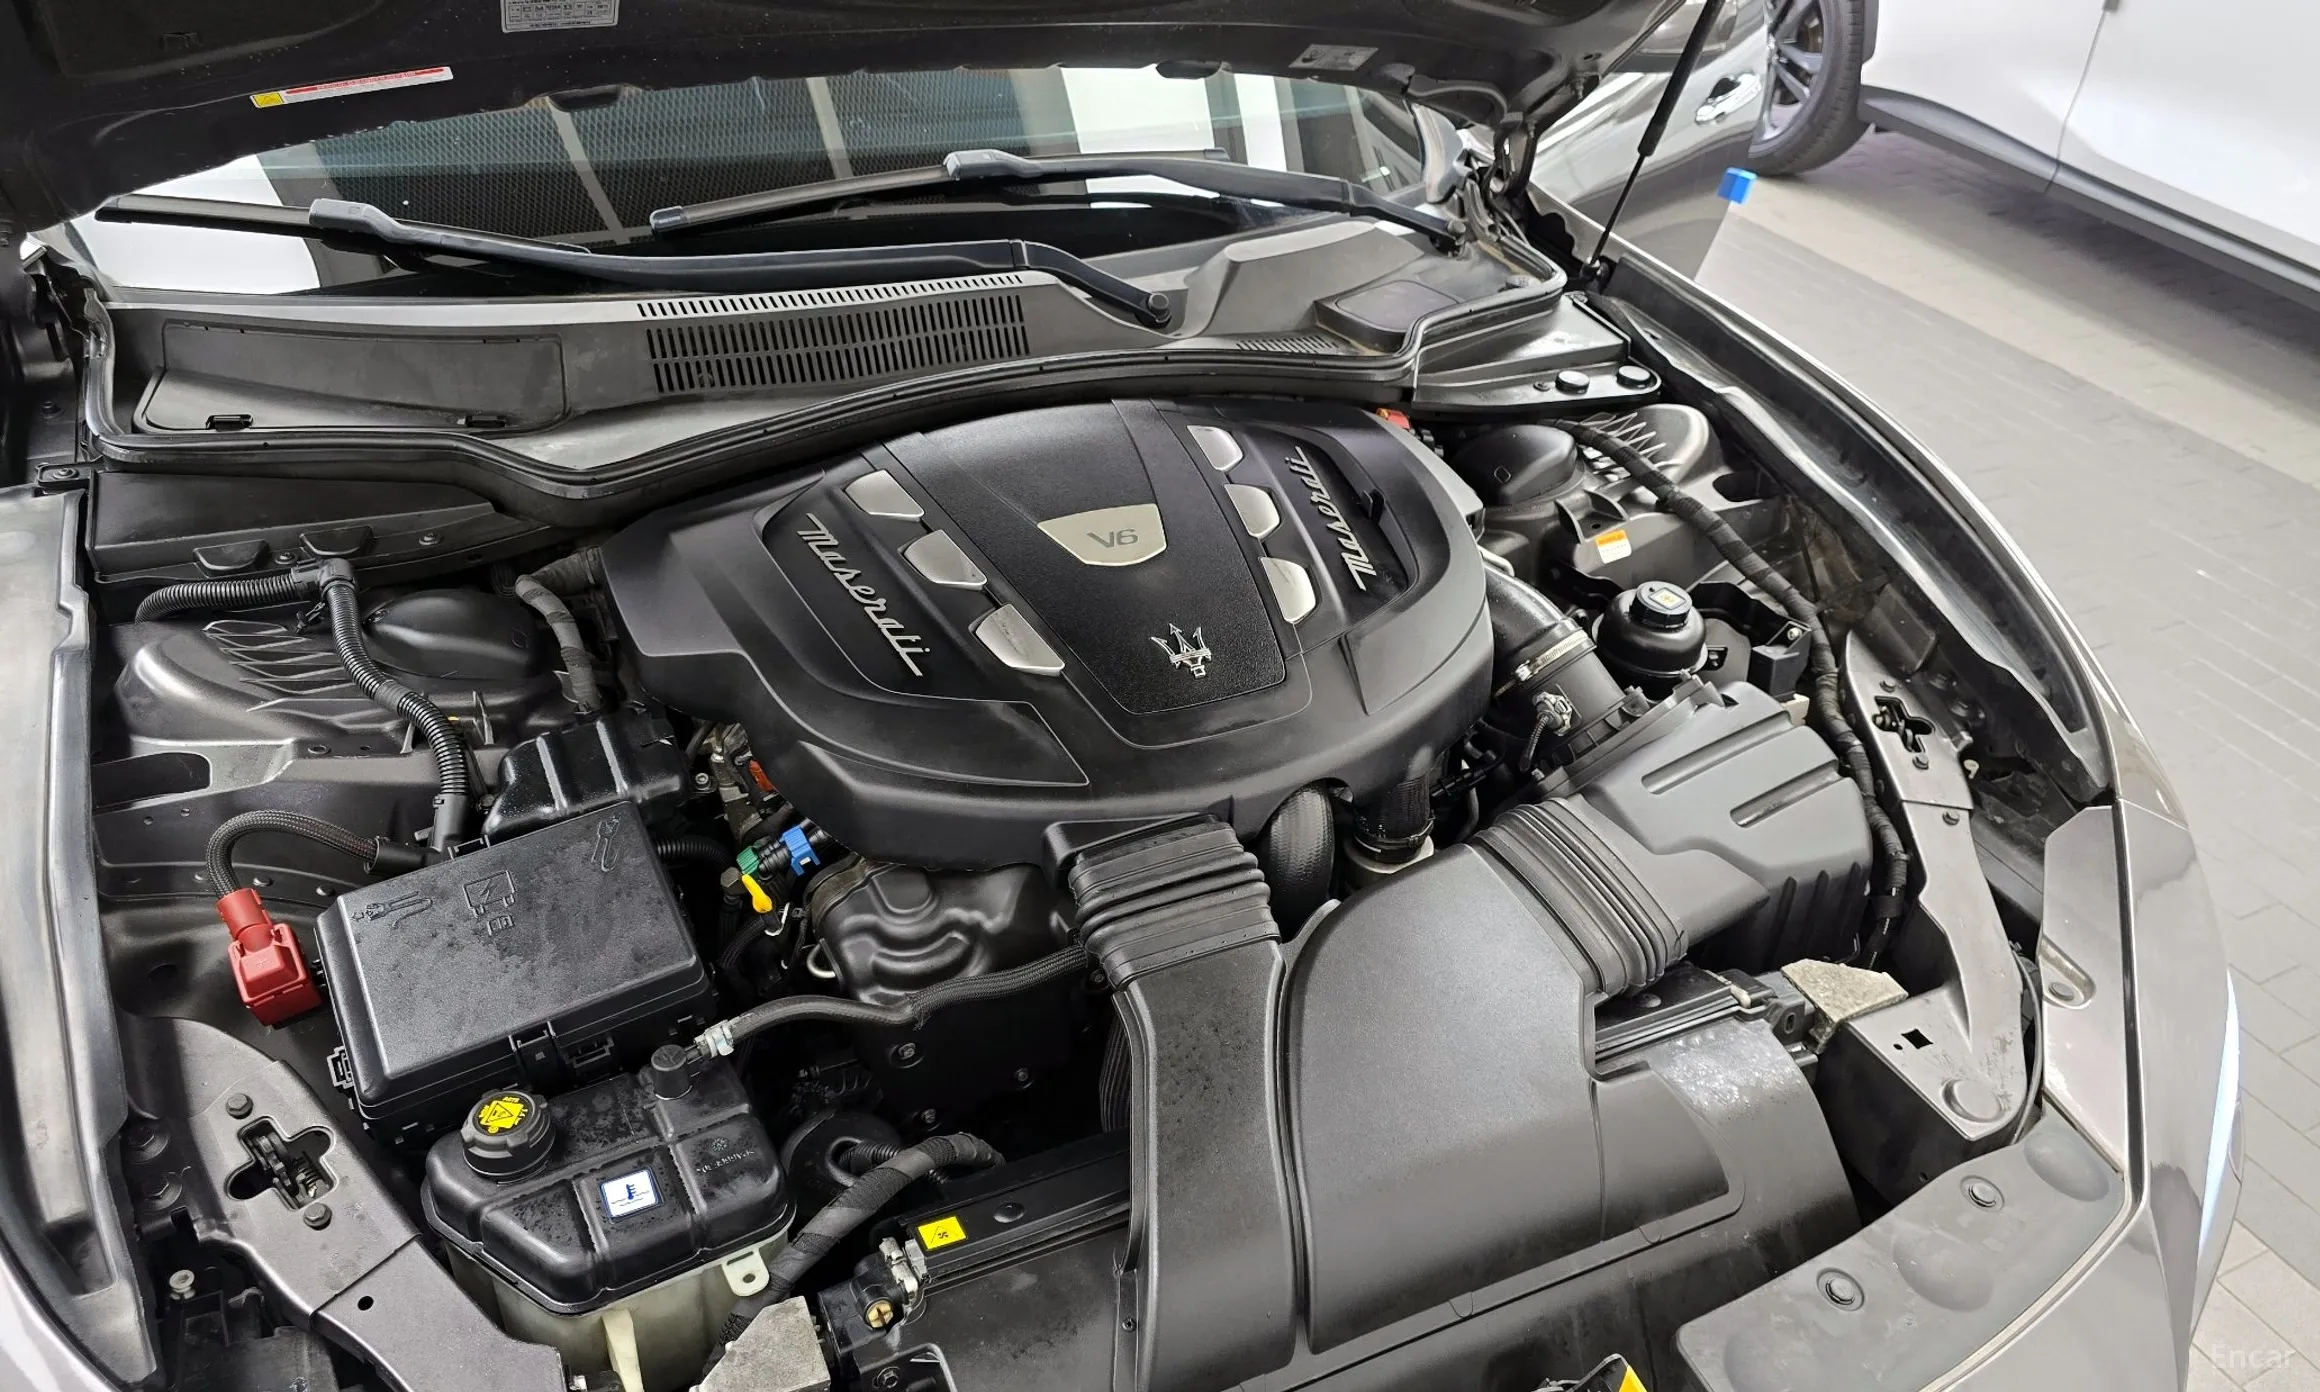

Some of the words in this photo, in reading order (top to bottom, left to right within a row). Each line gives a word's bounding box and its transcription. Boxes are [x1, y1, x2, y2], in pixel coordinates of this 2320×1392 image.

[1086, 528, 1139, 548] V6
[1285, 446, 1377, 591] Maserati
[797, 513, 930, 676] Maserati
